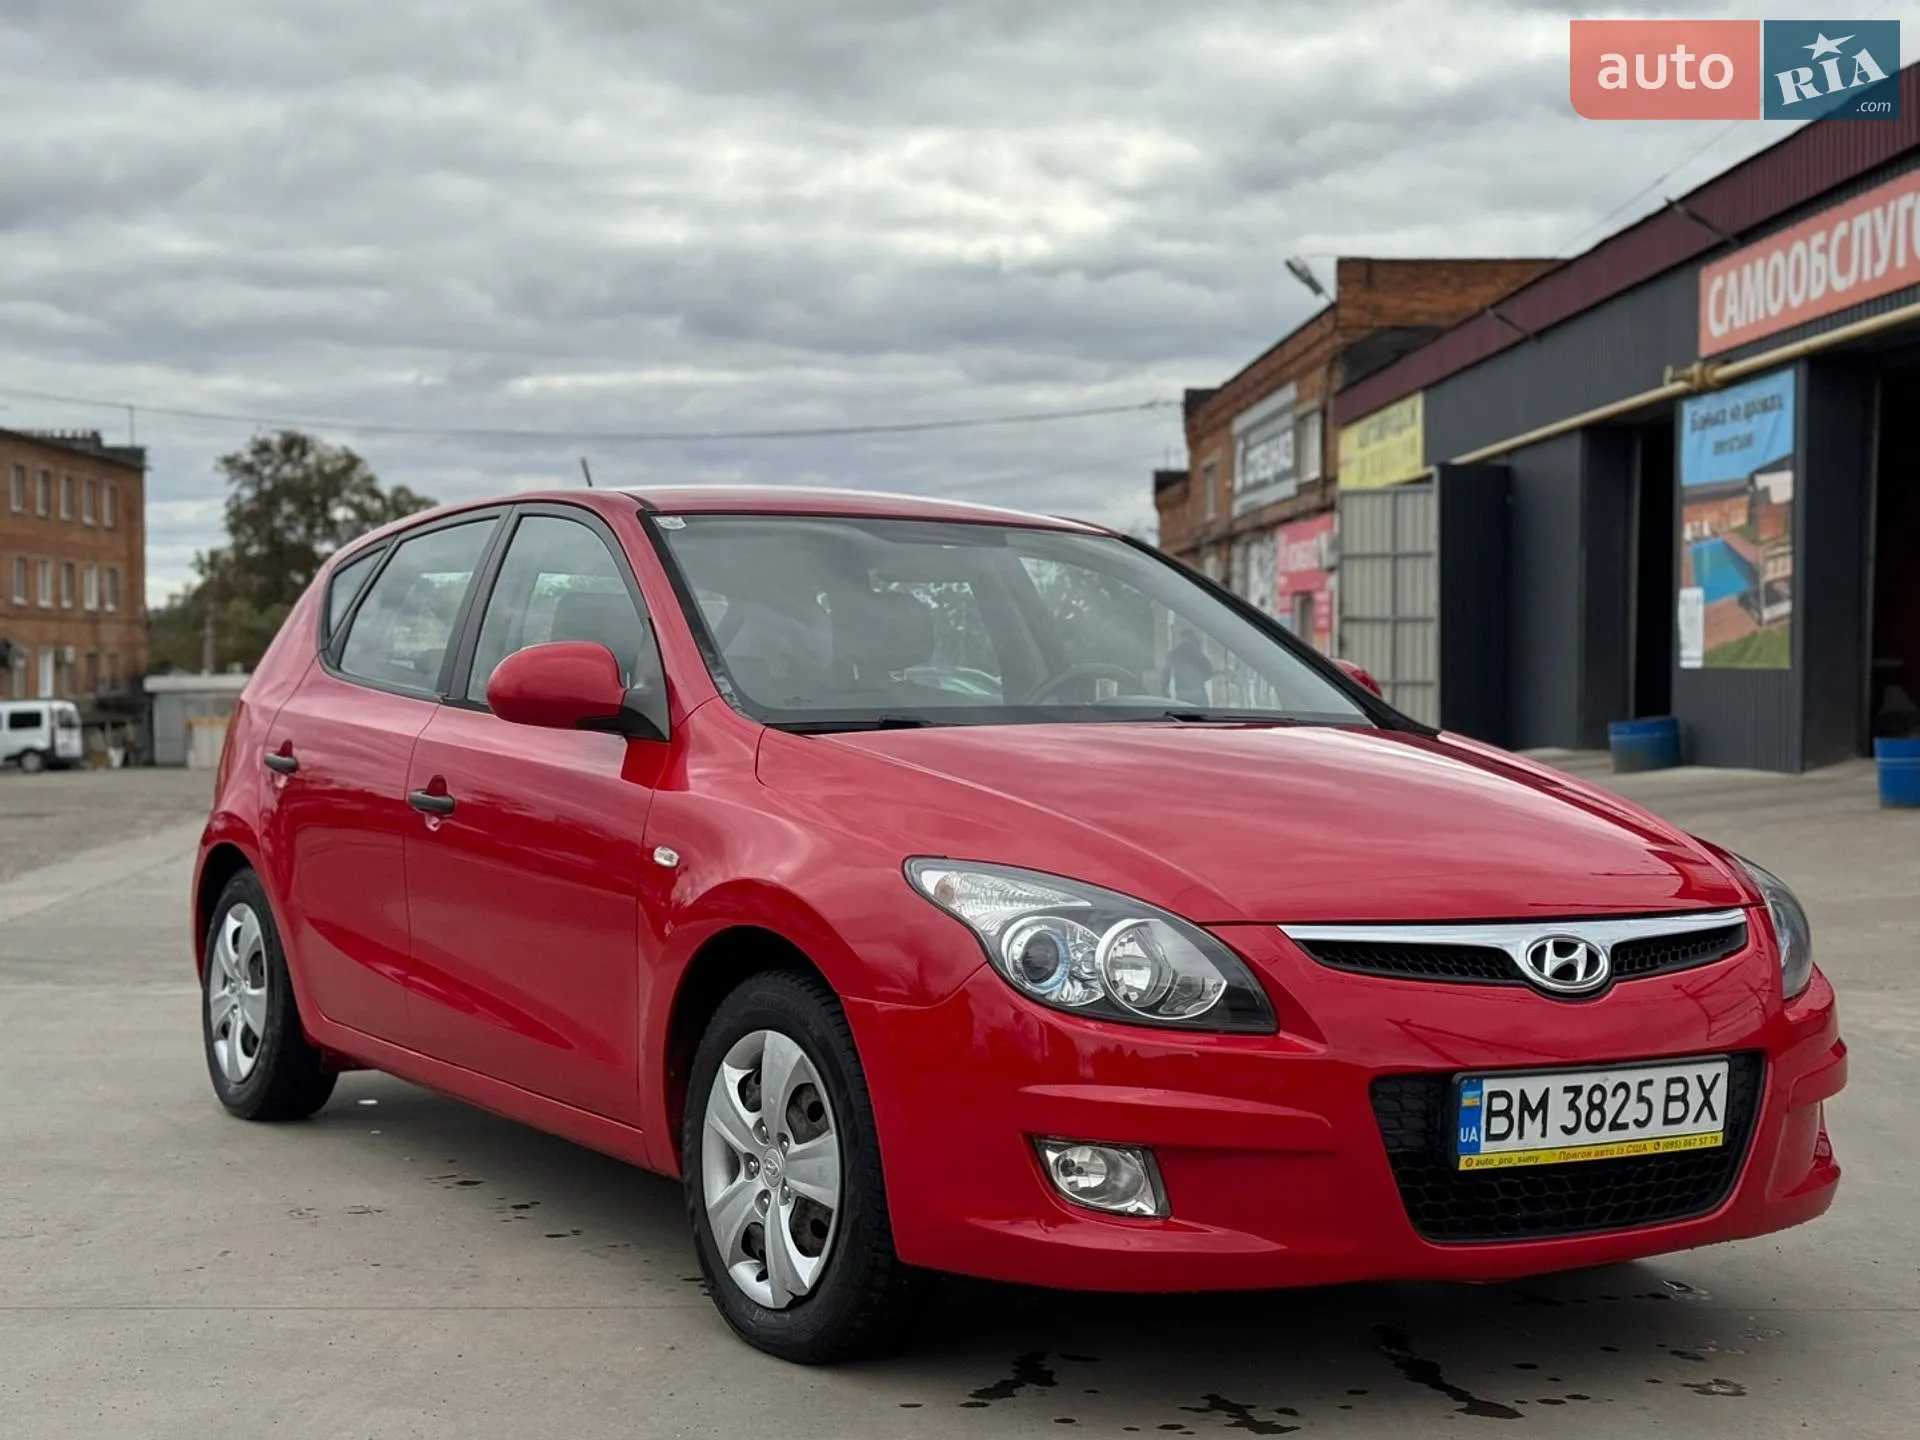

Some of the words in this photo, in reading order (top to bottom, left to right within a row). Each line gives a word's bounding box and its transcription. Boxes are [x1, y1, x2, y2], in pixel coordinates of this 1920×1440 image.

[1485, 1086, 1551, 1142] BM
[1560, 1078, 1654, 1136] 3825
[1662, 1072, 1721, 1126] BX
[1459, 1126, 1479, 1144] UA
[1626, 1143, 1648, 1154] США
